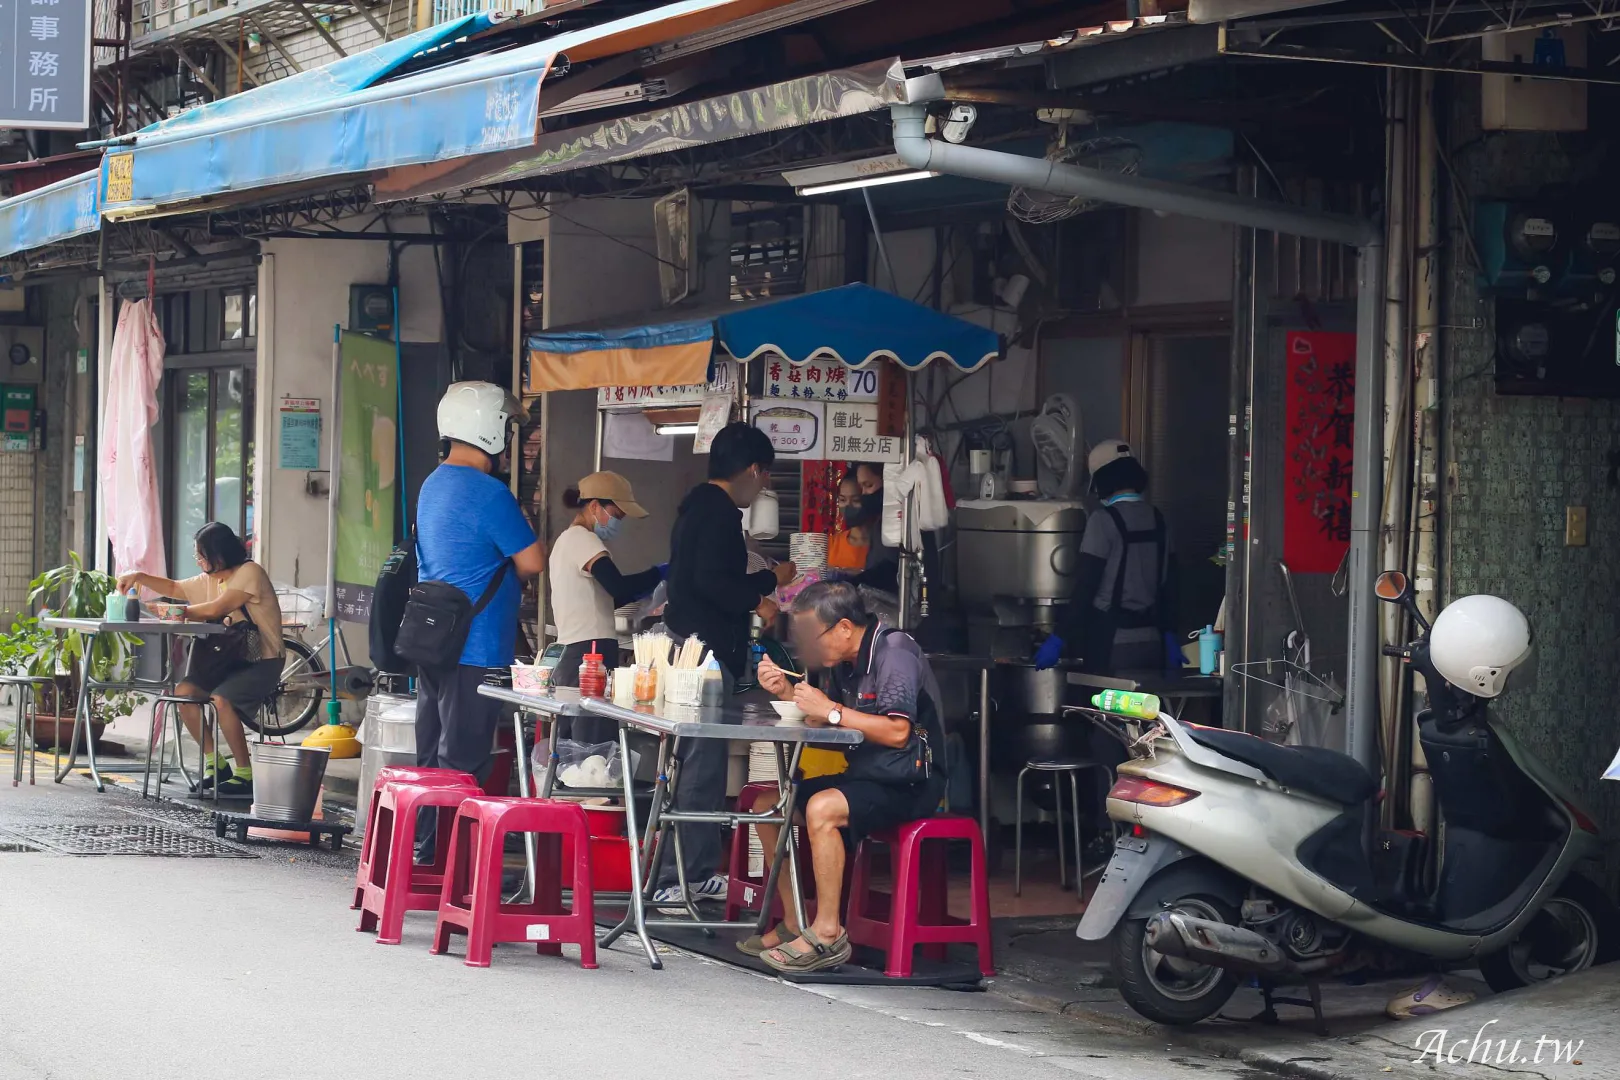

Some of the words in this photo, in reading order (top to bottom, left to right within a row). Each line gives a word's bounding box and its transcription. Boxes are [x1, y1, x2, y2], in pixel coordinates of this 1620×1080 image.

[29, 0, 60, 113] 事務所
[852, 369, 877, 394] 70
[831, 436, 893, 454] 別無分店
[1320, 361, 1355, 542] 恭賀新禧
